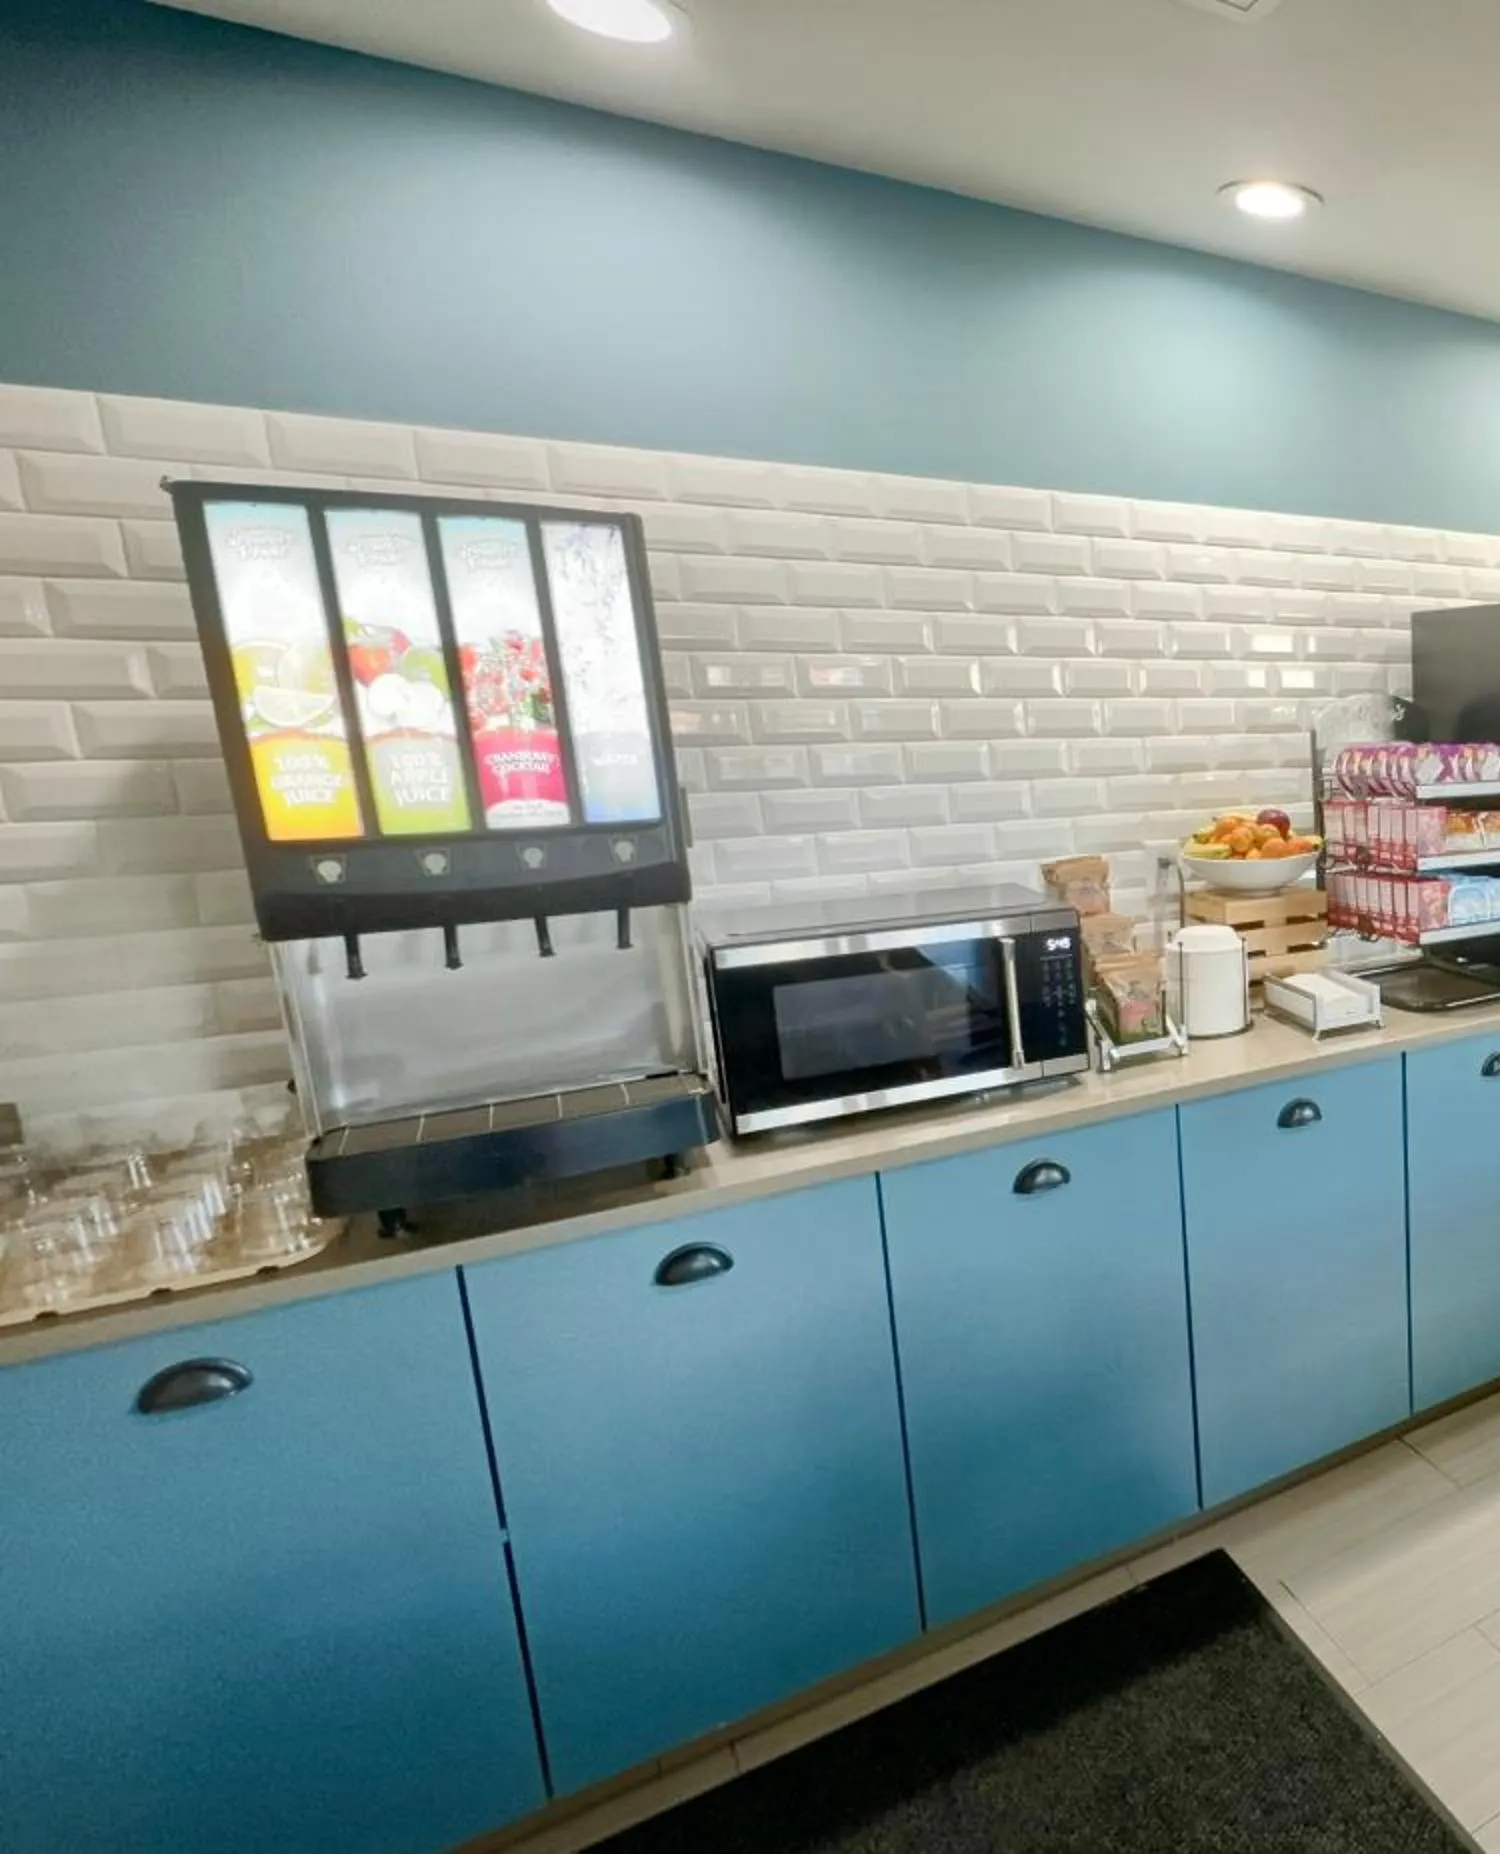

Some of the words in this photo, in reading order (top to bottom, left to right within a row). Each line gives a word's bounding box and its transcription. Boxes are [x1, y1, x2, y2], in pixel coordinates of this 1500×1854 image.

[272, 755, 327, 772] 100%
[389, 751, 444, 770] 100%
[390, 766, 449, 786] APPLE
[283, 787, 335, 808] JUICE
[394, 785, 452, 808] JUICE
